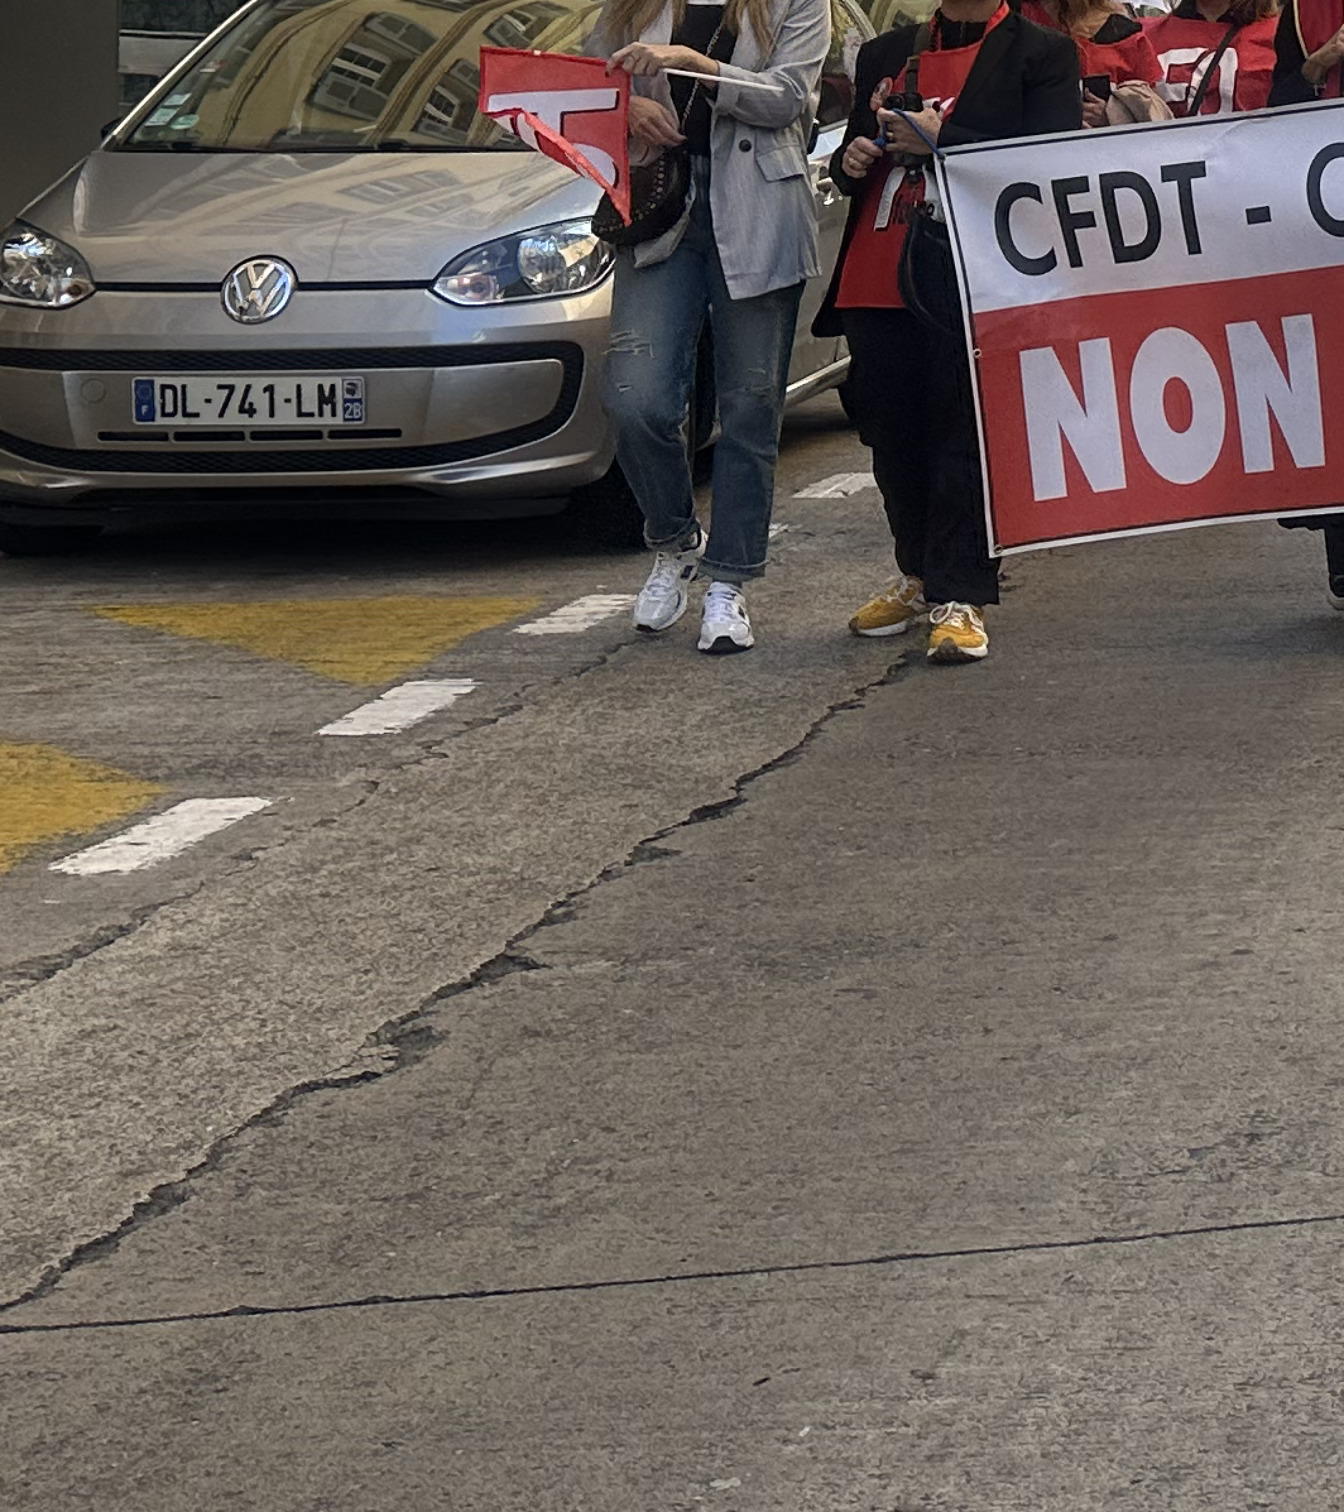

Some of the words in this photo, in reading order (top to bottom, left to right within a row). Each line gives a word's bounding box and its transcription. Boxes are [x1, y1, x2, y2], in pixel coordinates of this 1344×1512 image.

[995, 160, 1206, 276] CFDT
[159, 383, 337, 419] DL-741-LM
[344, 402, 362, 419] 2B
[1019, 313, 1326, 502] NON
